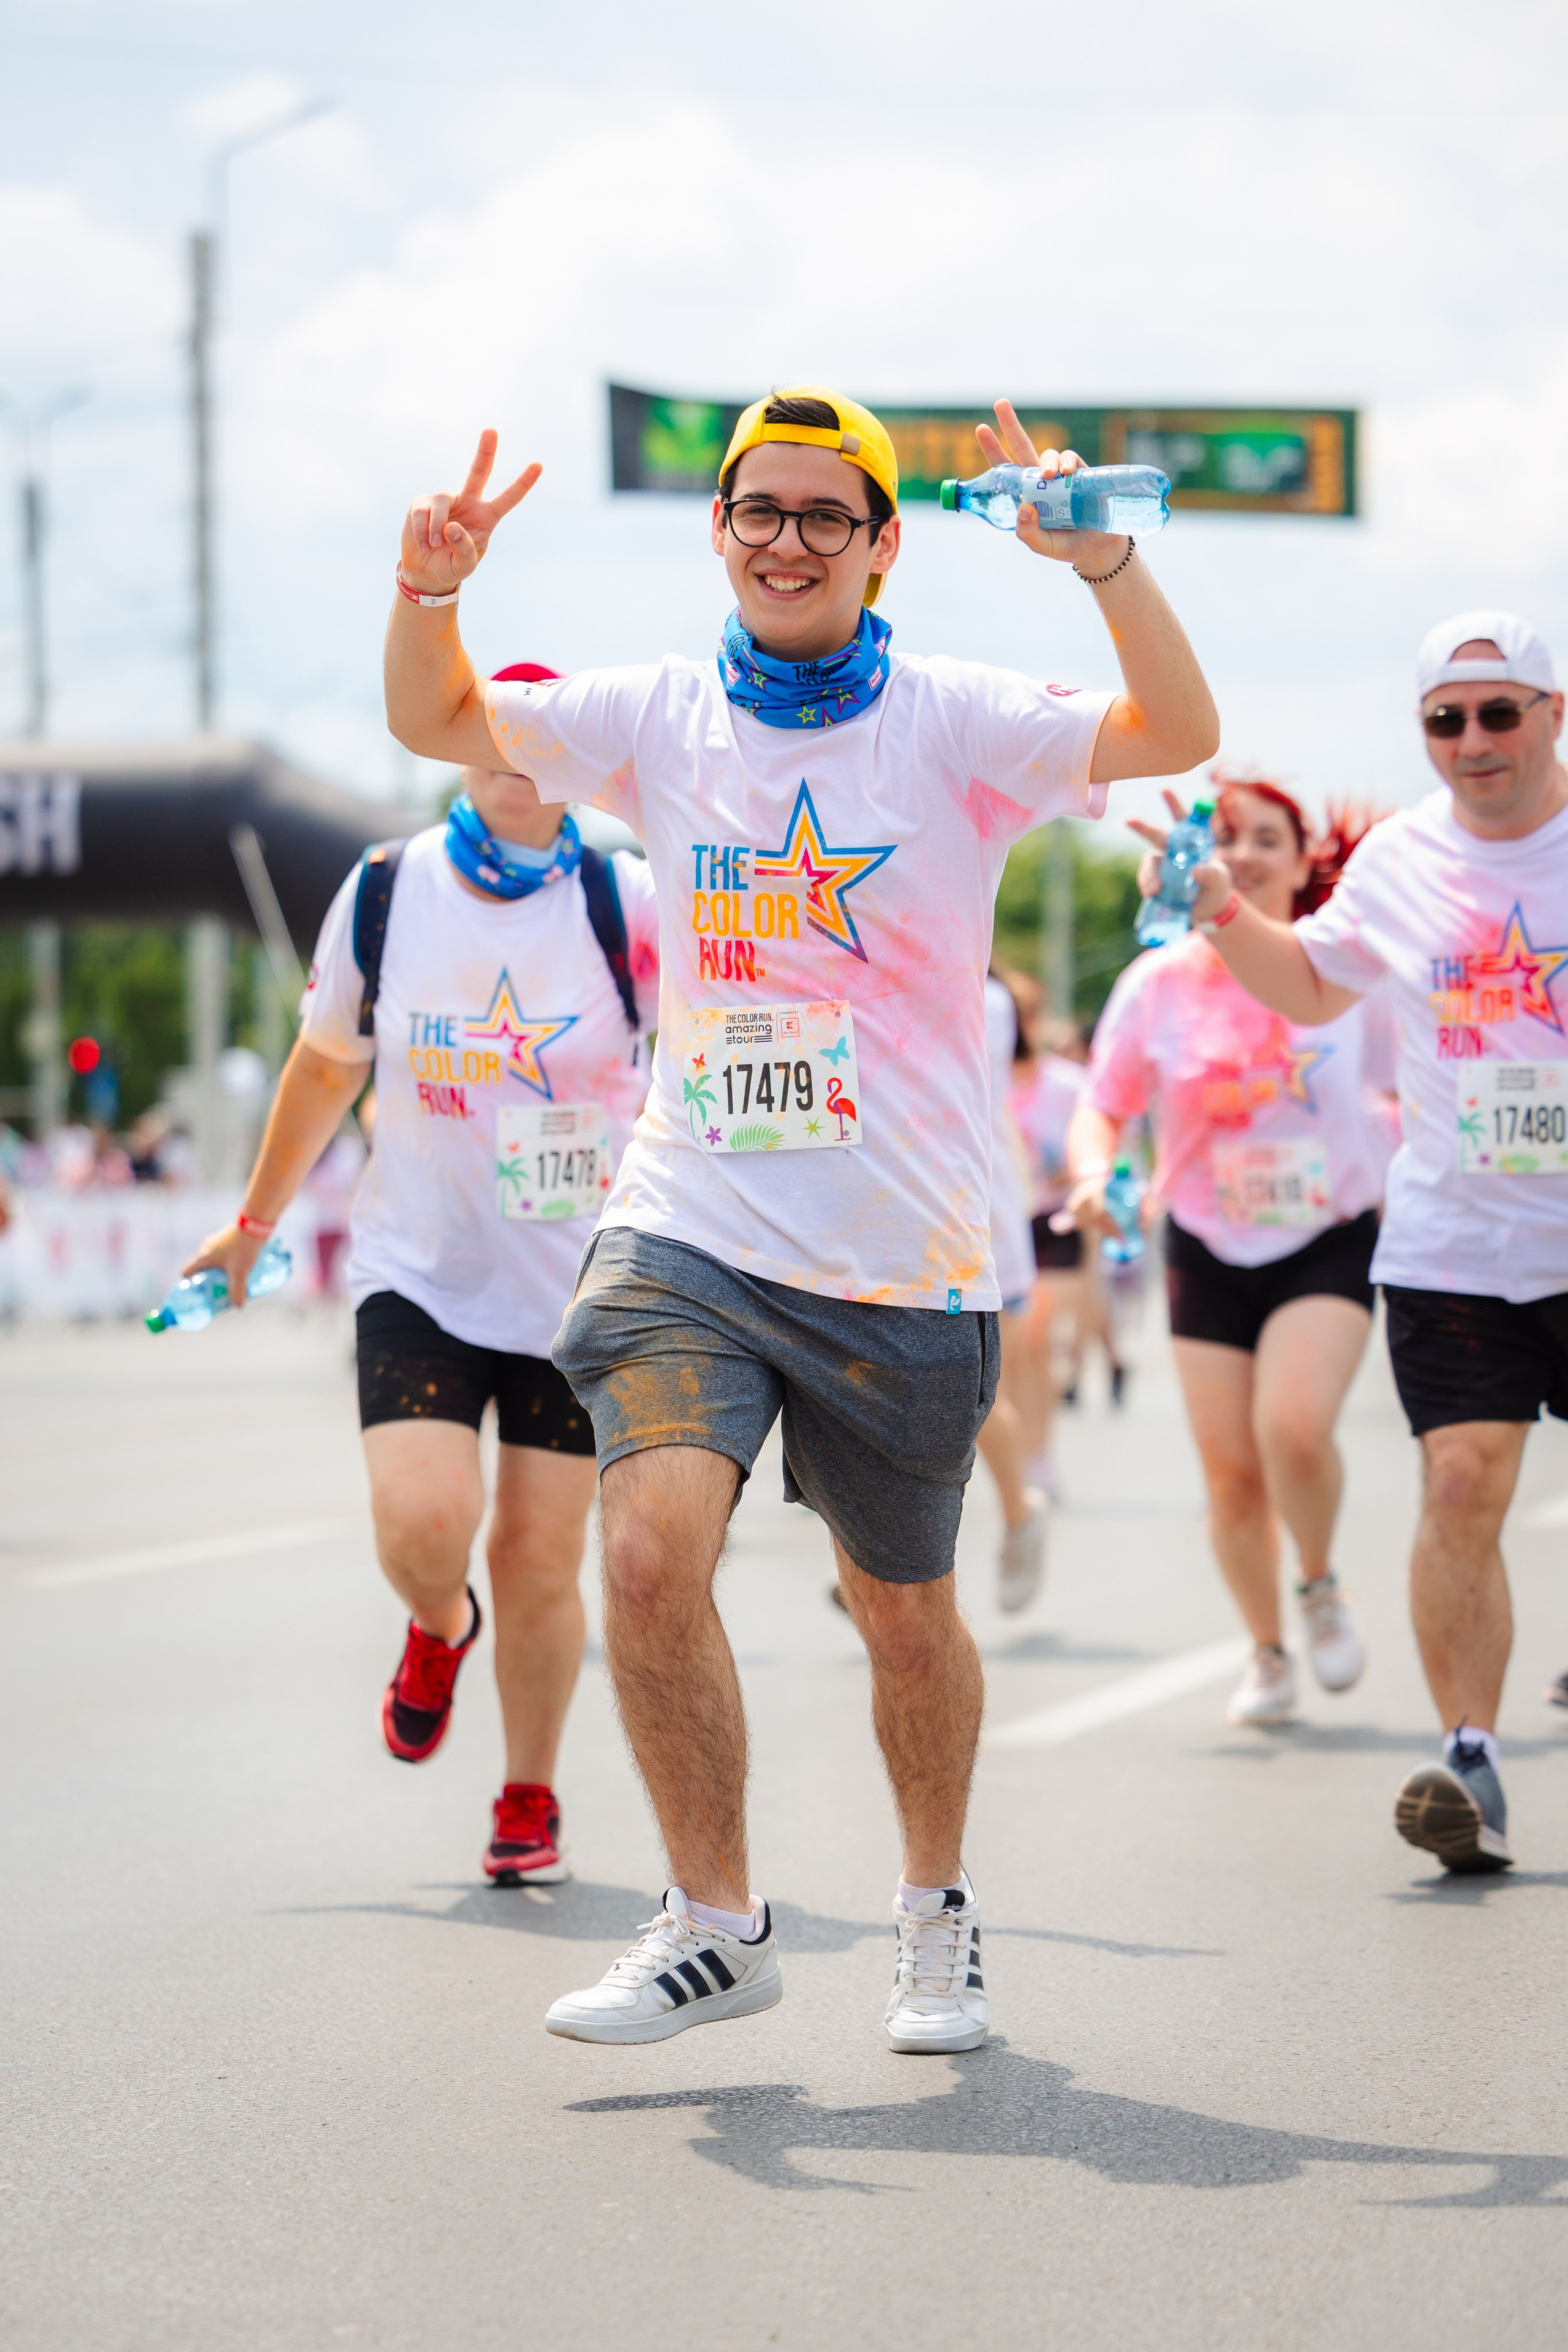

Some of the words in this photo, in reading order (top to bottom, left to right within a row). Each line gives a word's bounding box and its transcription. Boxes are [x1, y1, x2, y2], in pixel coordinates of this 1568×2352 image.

[792, 661, 821, 682] THE
[692, 844, 750, 891] THE
[693, 891, 799, 939] COLOR
[699, 937, 756, 982] RUN
[726, 1014, 737, 1023] THE
[737, 1013, 758, 1023] COLOR
[1428, 989, 1515, 1023] COLOR
[409, 1013, 457, 1047] THE
[725, 1023, 772, 1035] amazing
[733, 1035, 753, 1044] tour
[1438, 1027, 1482, 1060] RUN
[408, 1048, 503, 1085] COLOR
[417, 1082, 467, 1120] RUN
[723, 1060, 814, 1115] 17479
[1493, 1104, 1566, 1145] 17480
